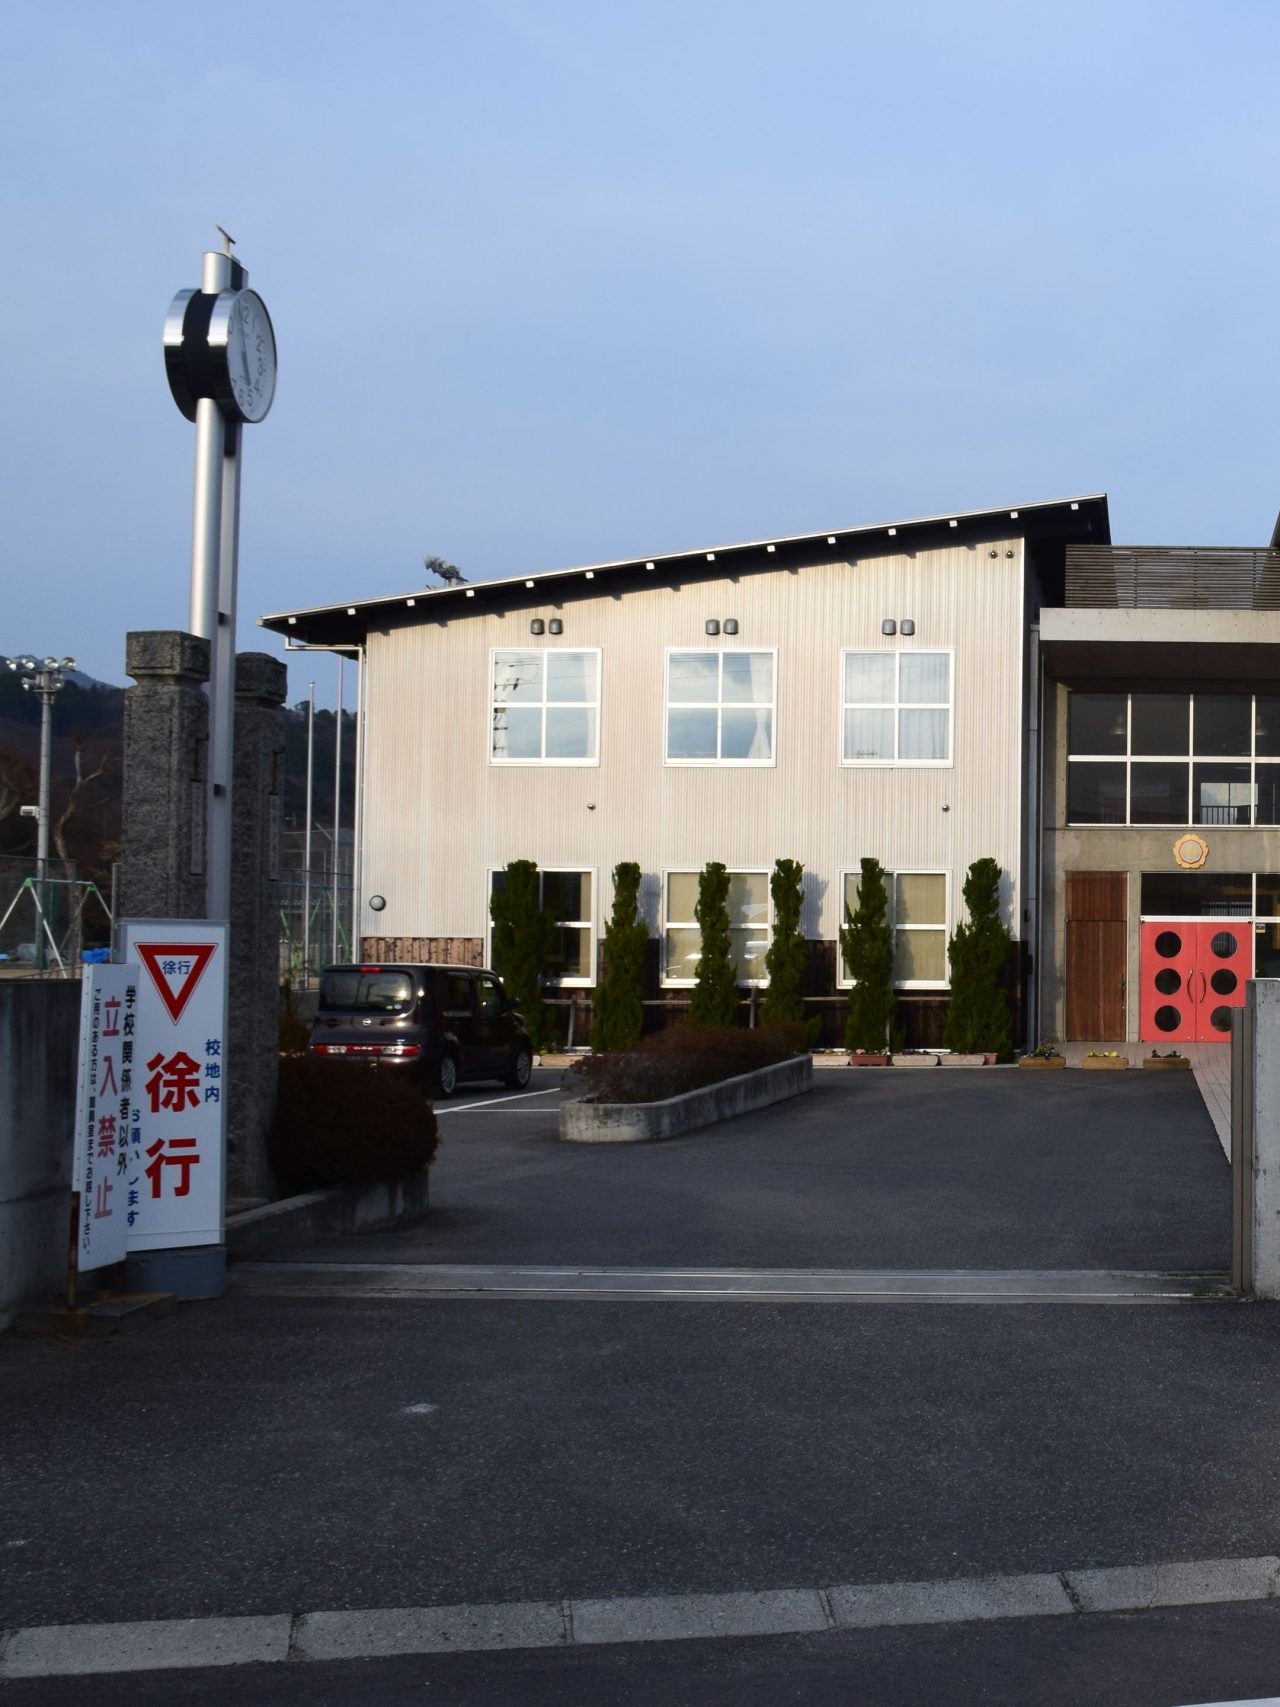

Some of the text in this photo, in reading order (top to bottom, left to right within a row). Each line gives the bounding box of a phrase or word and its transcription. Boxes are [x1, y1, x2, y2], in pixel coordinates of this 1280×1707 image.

[162, 960, 191, 976] 徐行
[94, 995, 121, 1220] 立入禁止
[117, 984, 137, 1177] 学校関係者以外
[145, 1051, 201, 1200] 徐行
[204, 1038, 222, 1104] 校地内
